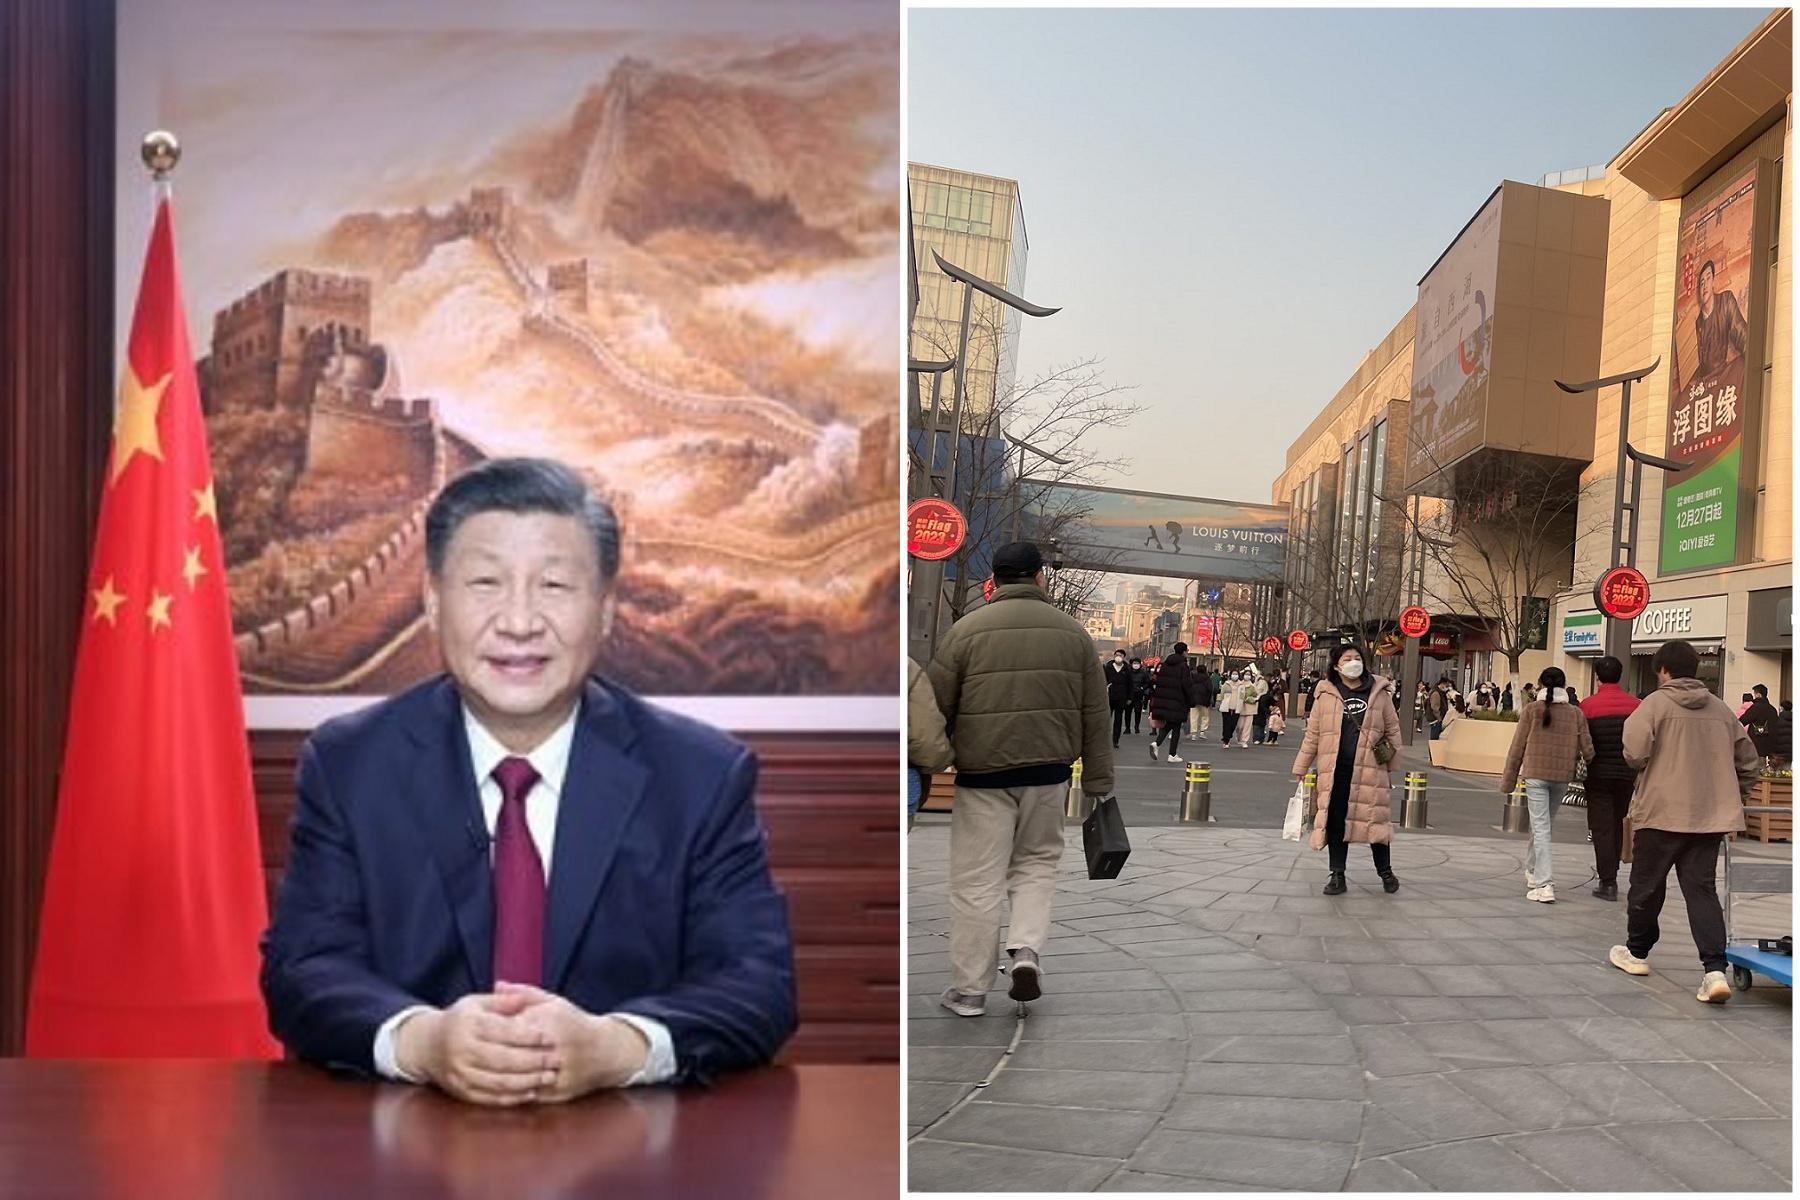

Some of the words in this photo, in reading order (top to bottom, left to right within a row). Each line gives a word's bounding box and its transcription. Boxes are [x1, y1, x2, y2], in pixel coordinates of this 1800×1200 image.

[1672, 384, 1738, 447] 浮图缘
[1676, 501, 1722, 529] 12月27日起
[927, 519, 952, 533] Flag
[914, 530, 946, 545] 2023
[1192, 526, 1229, 539] LOUIS
[1232, 529, 1283, 544] VUITTON
[1620, 584, 1639, 596] Flag
[1611, 593, 1635, 606] 2023
[1644, 607, 1692, 635] COFFEE
[1573, 631, 1597, 643] FamilyMart
